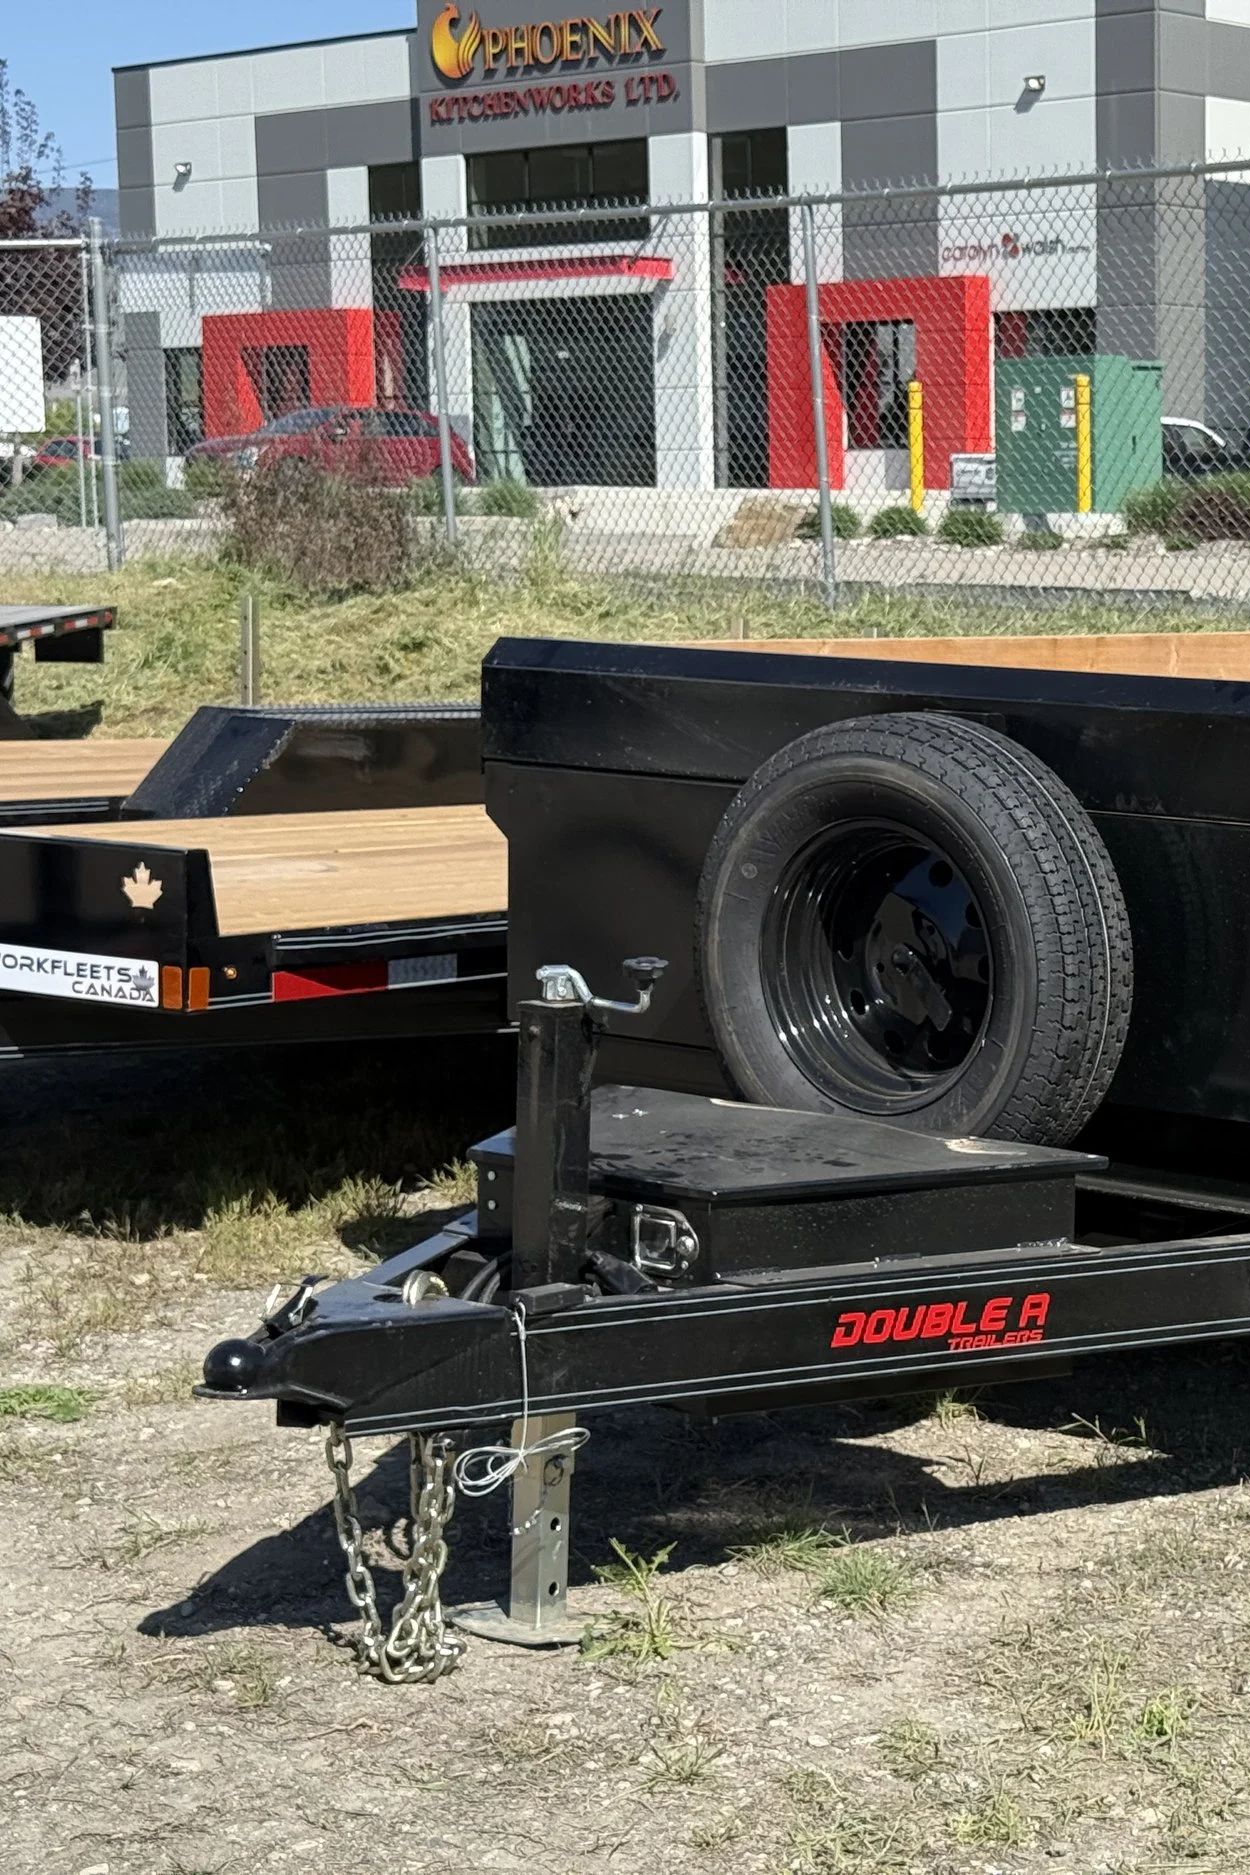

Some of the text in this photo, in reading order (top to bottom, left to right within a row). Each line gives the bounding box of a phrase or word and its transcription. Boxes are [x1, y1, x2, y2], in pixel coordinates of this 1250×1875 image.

[483, 8, 664, 69] PHOENIX
[430, 80, 615, 122] KITCHENWORKS
[0, 953, 132, 983] ORKFLEETS
[72, 981, 155, 1003] CANADA
[830, 1293, 1050, 1348] DOUBLE A
[947, 1329, 1044, 1352] TRAILERS
